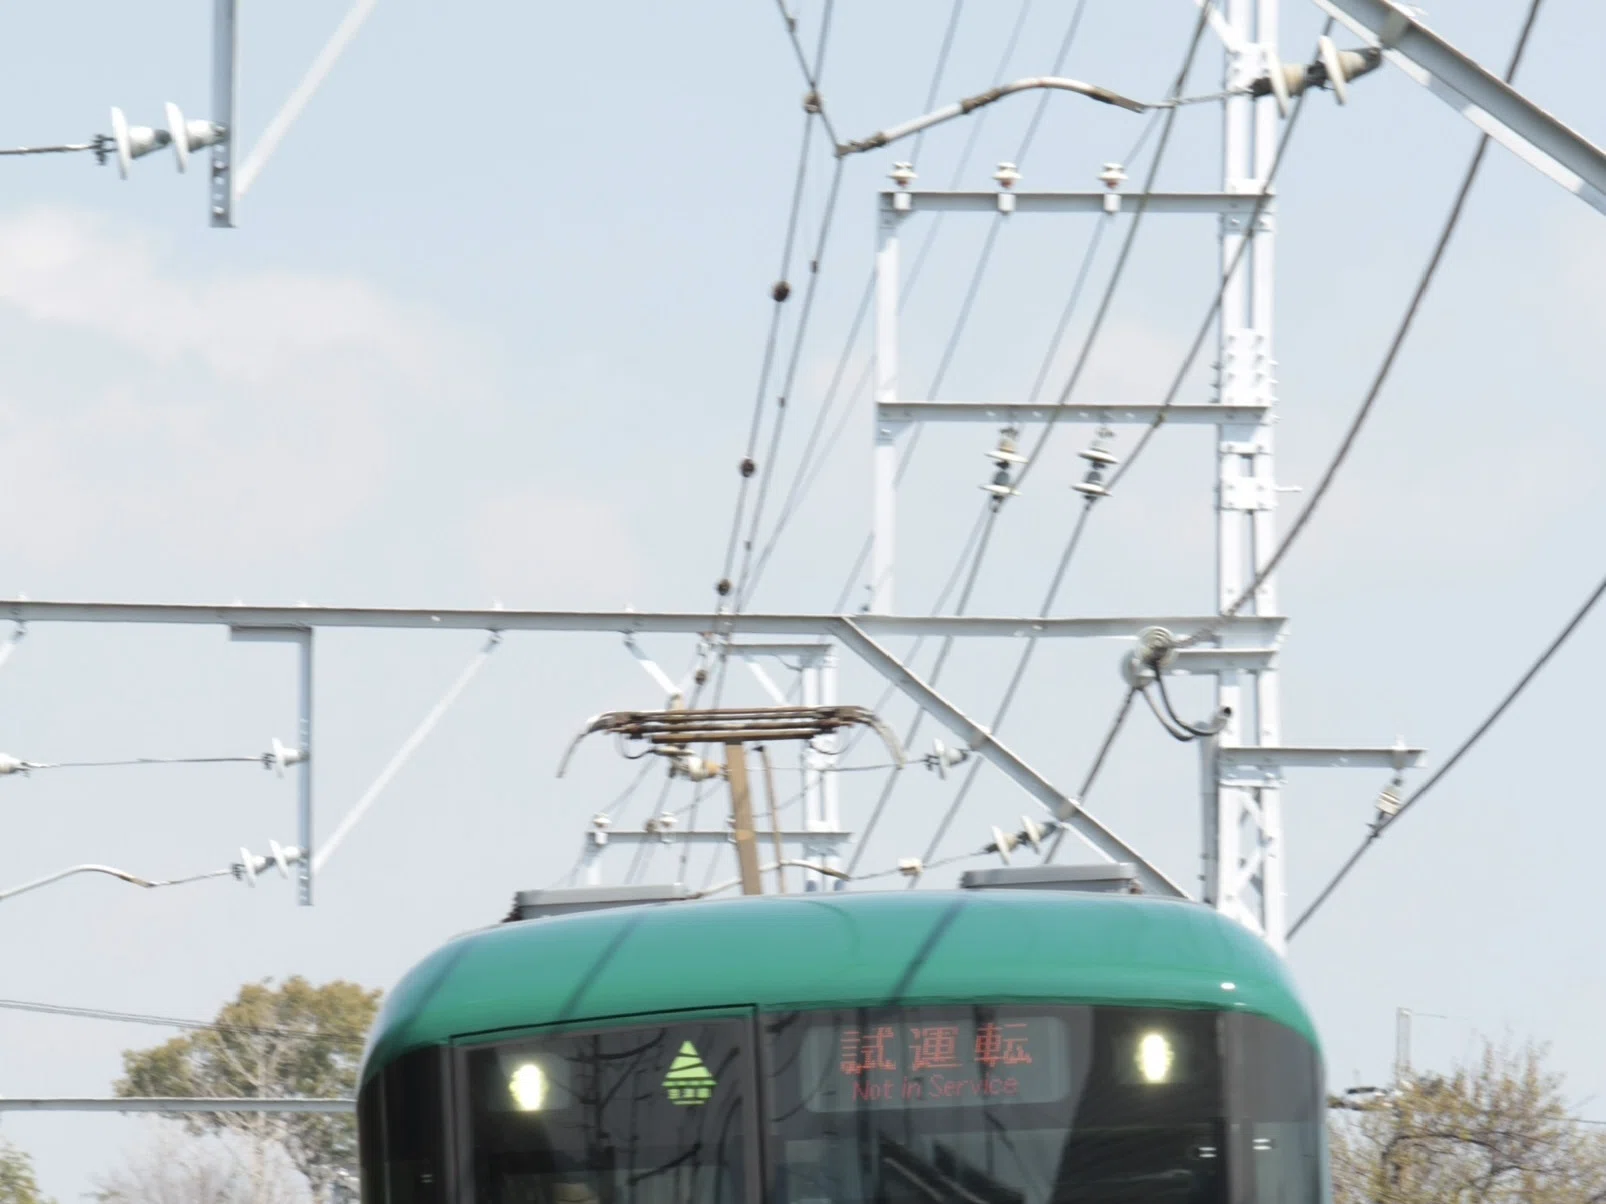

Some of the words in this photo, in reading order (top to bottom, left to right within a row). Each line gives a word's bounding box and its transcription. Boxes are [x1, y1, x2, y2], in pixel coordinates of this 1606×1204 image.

[840, 1022, 1032, 1075] 試運転
[852, 1079, 895, 1101] Not
[902, 1076, 922, 1100] in
[928, 1073, 1018, 1099] Service
